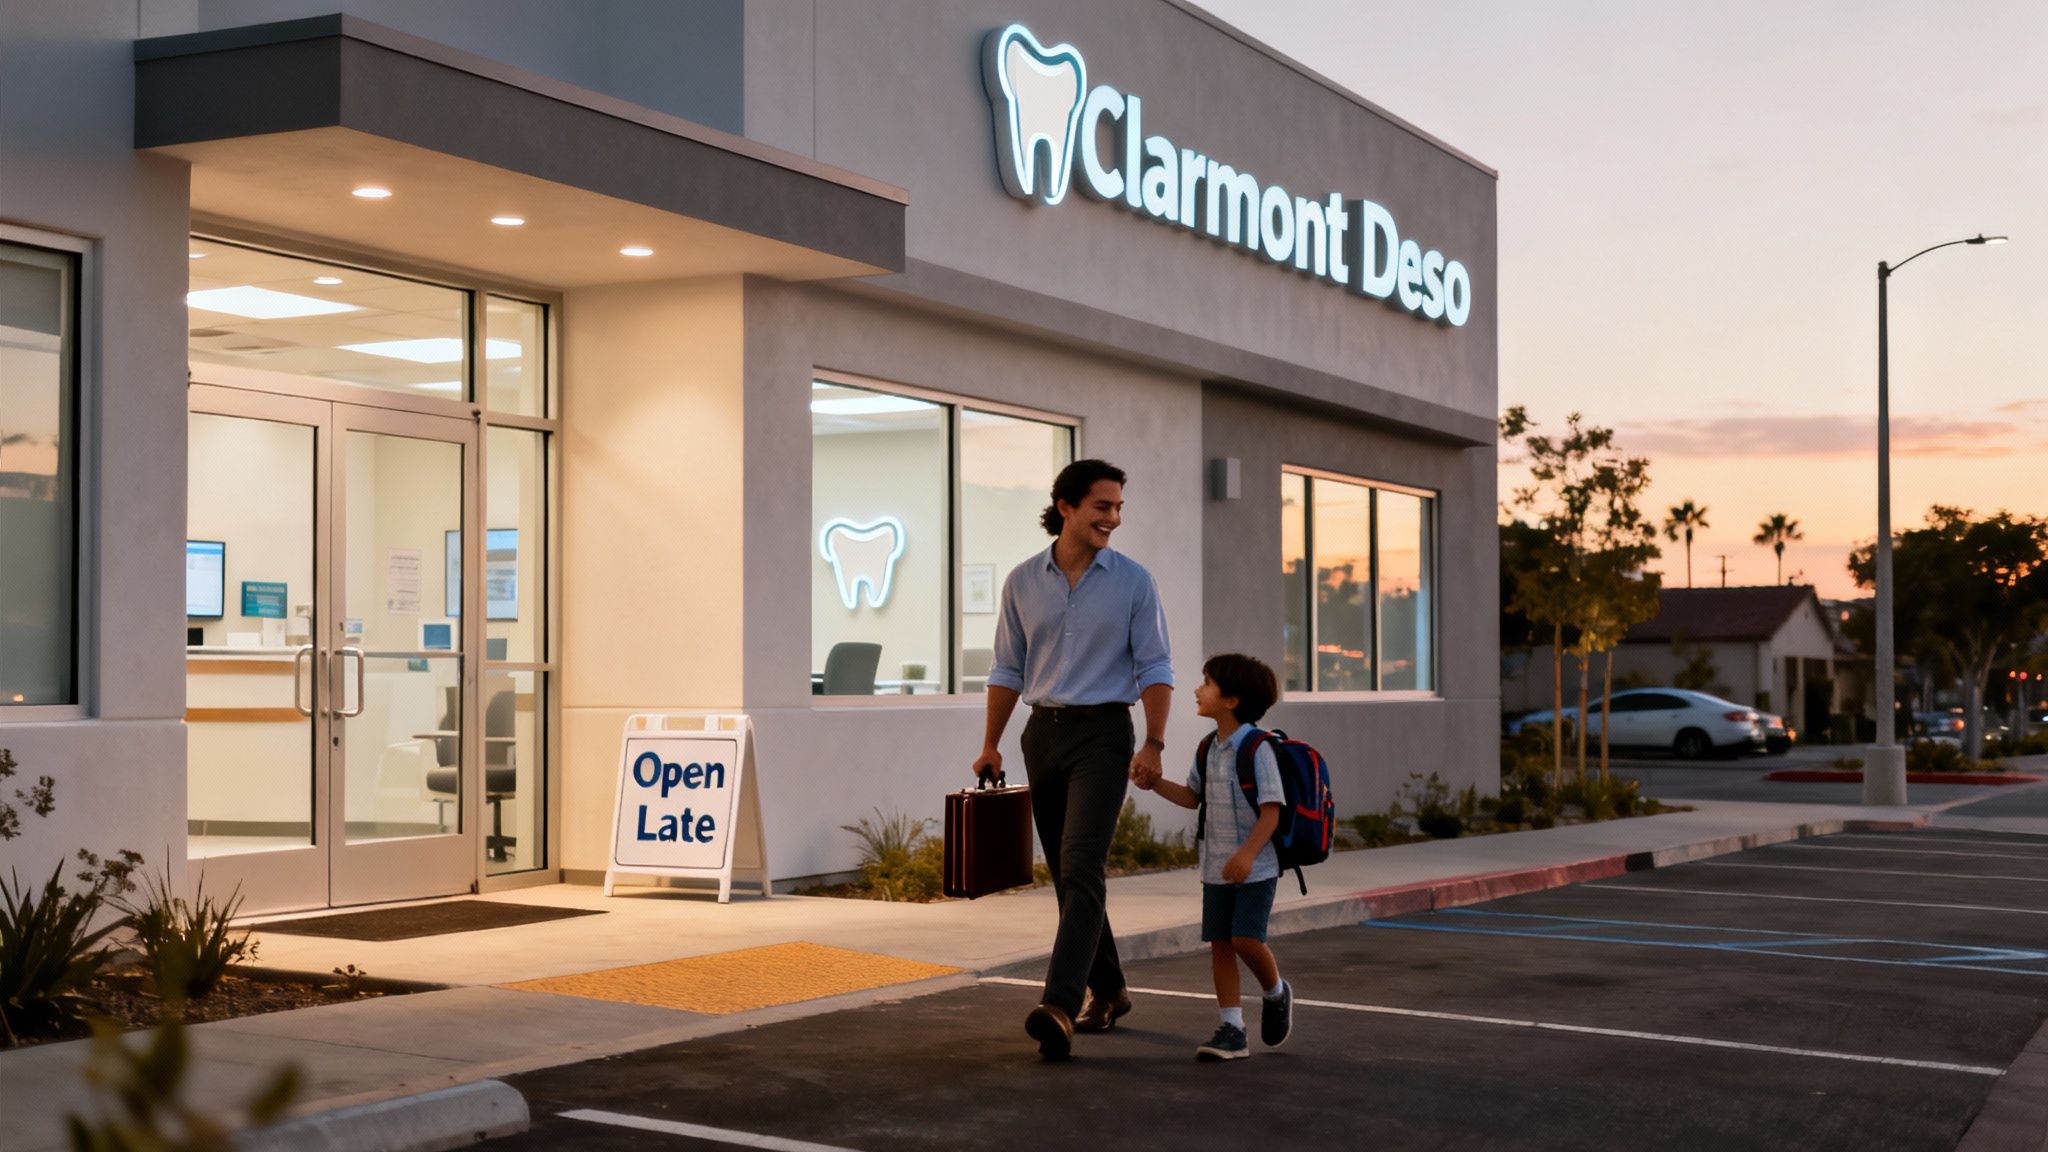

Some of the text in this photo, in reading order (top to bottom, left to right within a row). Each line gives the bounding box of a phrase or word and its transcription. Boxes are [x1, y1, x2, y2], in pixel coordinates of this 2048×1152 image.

[1081, 84, 1471, 327] Clarmont Deso
[633, 751, 725, 798] Open
[637, 804, 716, 843] Late
